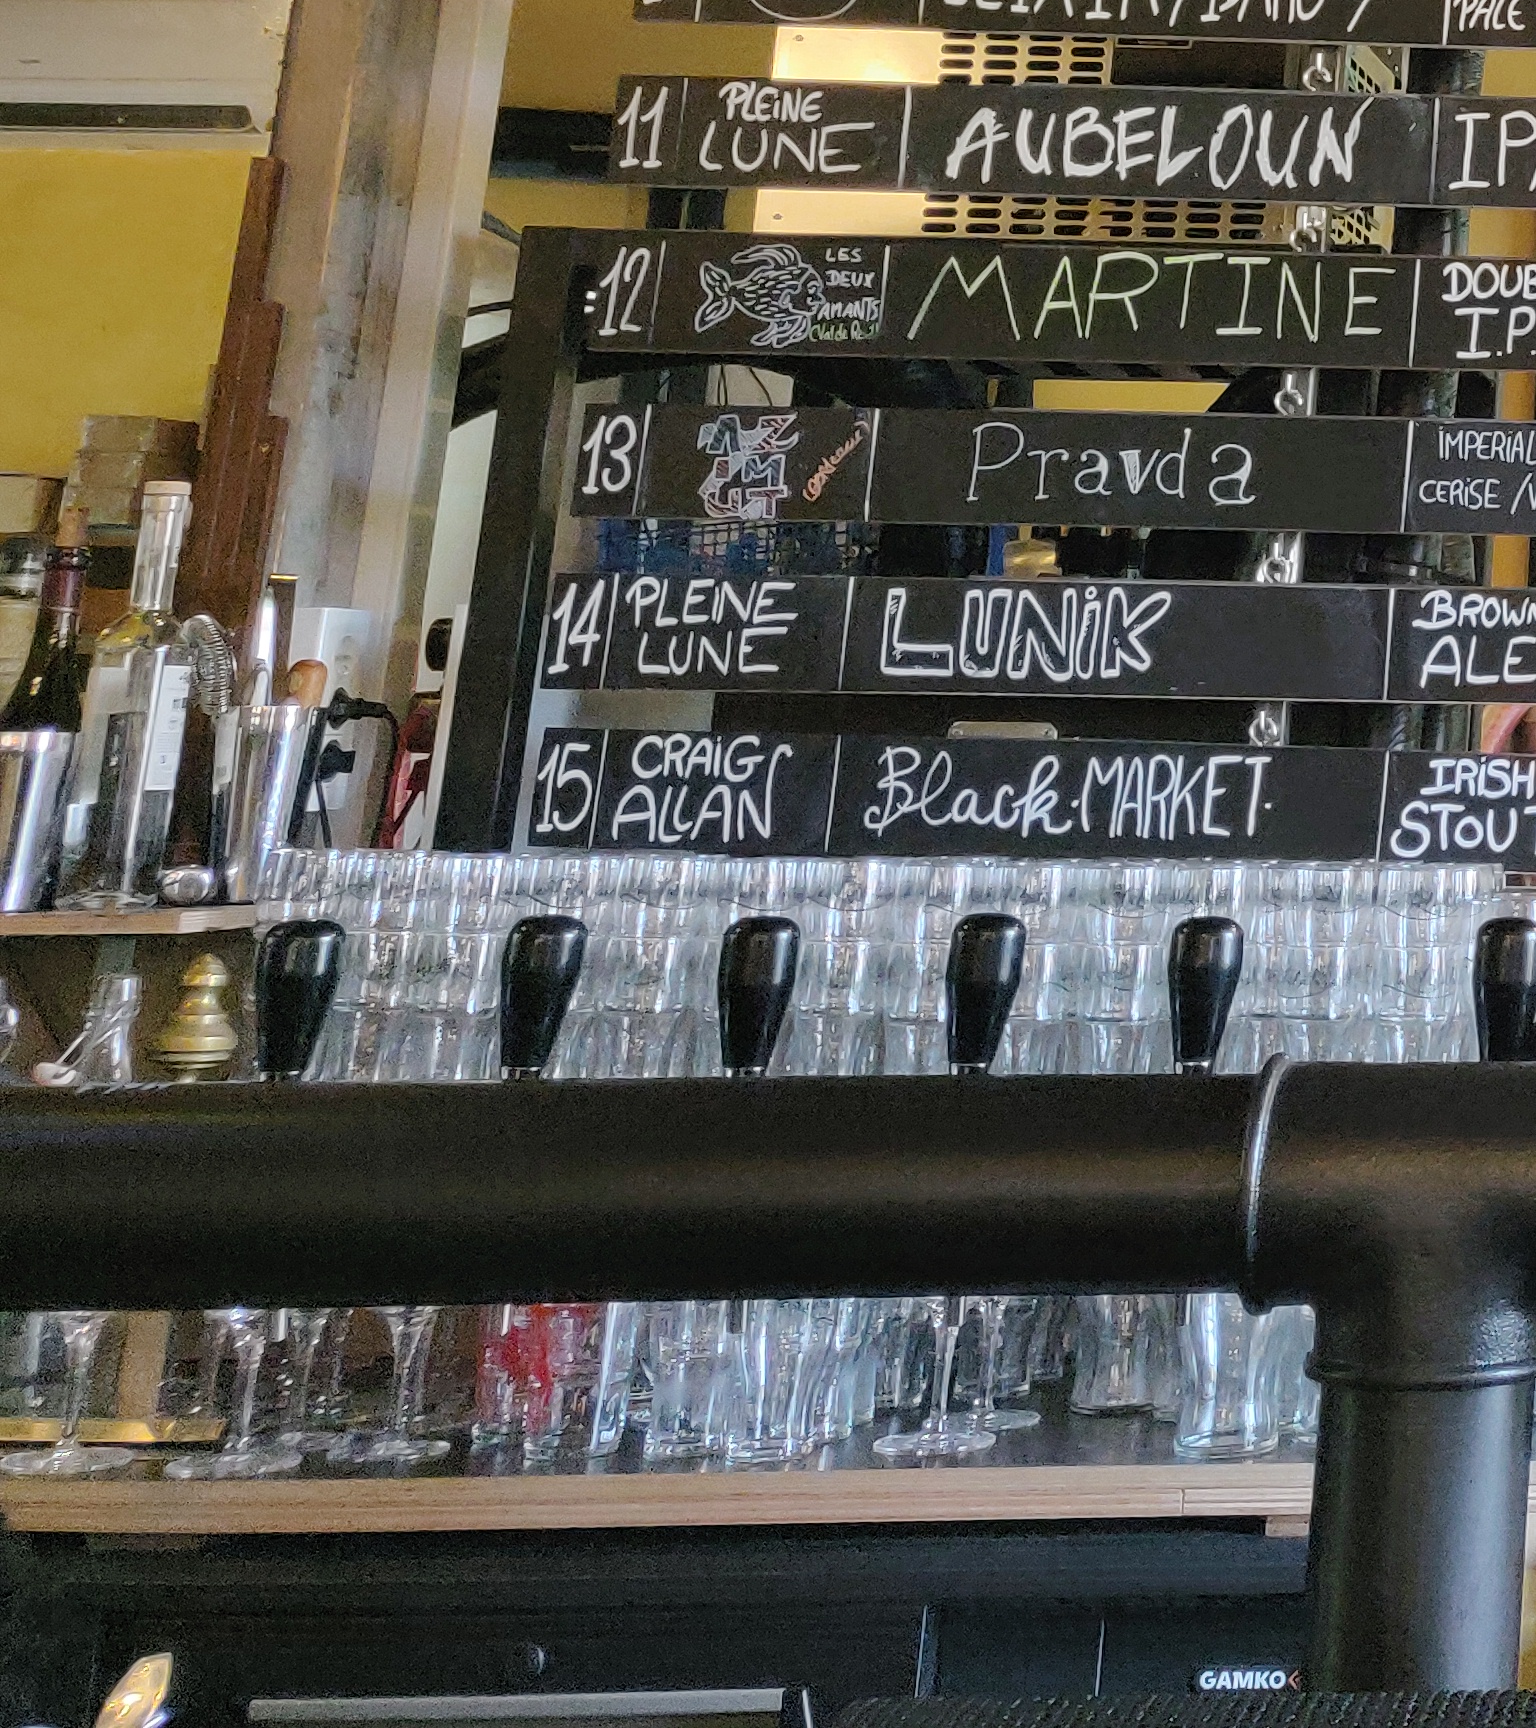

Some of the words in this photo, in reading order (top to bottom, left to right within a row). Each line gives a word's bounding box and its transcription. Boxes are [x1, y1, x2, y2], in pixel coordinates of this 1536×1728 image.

[617, 85, 669, 169] 11
[698, 119, 876, 174] LUNE
[945, 95, 1375, 191] AUBELOUN
[598, 246, 651, 337] 12
[825, 247, 862, 263] LES
[907, 249, 1396, 343] MARTINE
[581, 414, 638, 498] 13
[549, 578, 604, 675] 14
[637, 626, 789, 676] LUNE
[534, 741, 594, 837] 15
[1200, 1670, 1286, 1690] GAMKO
